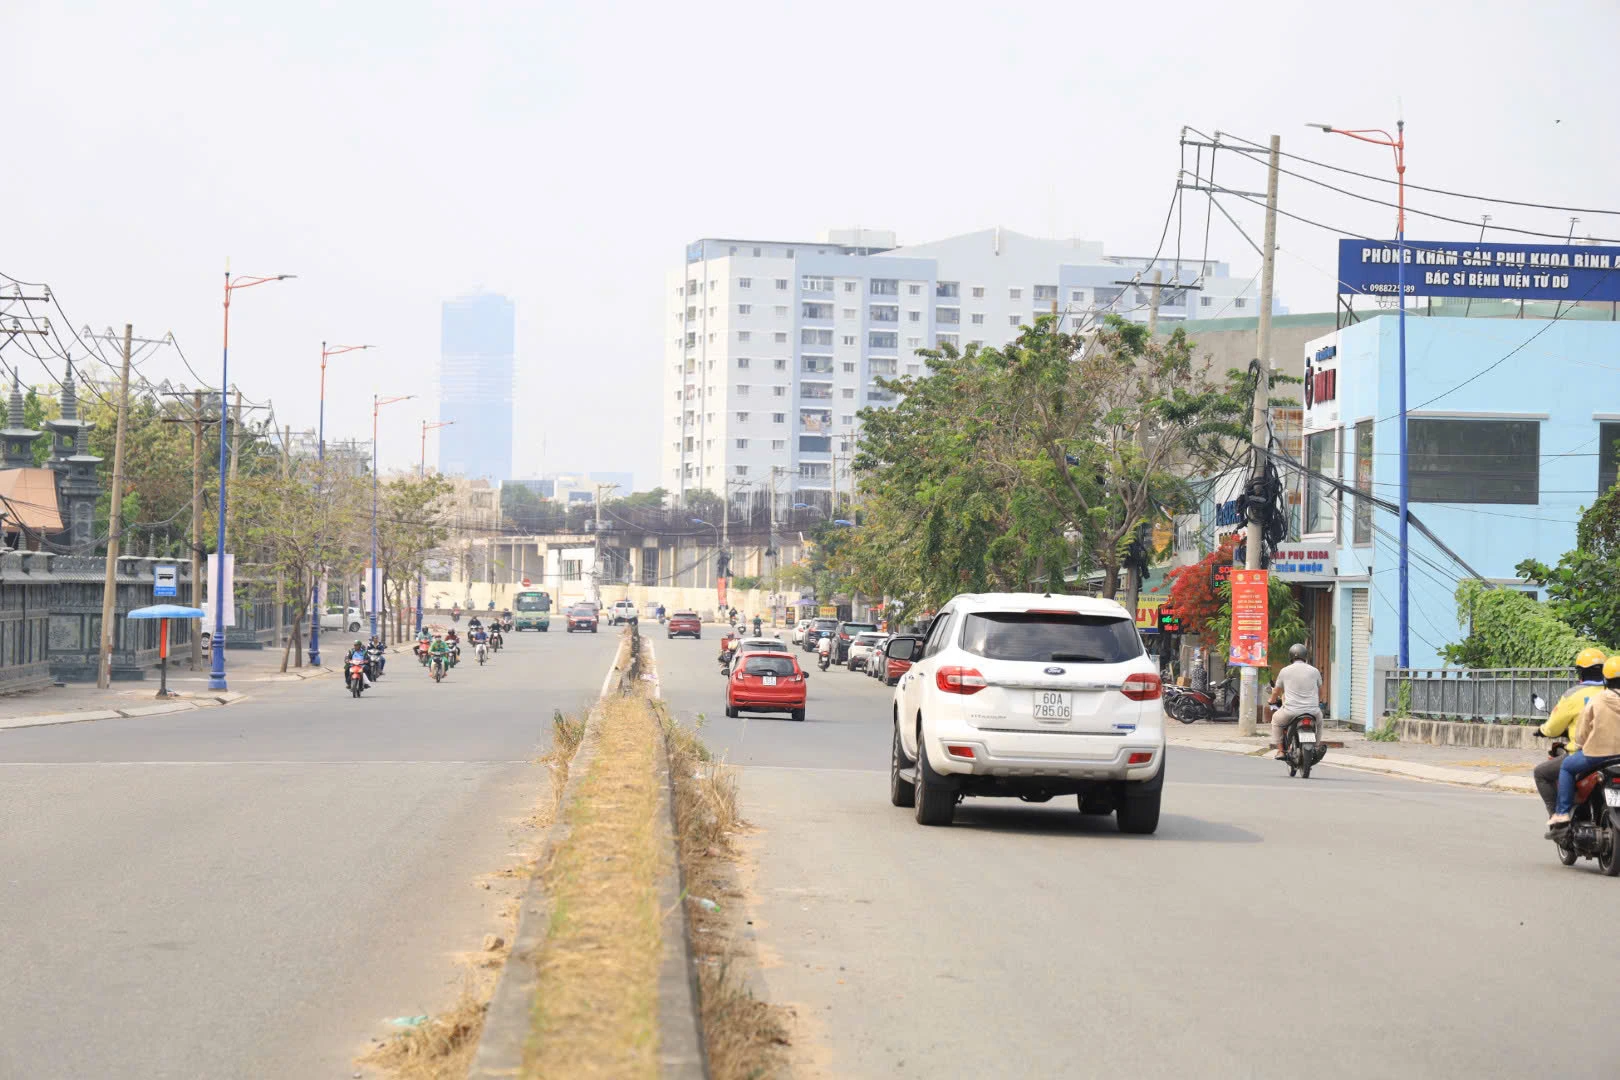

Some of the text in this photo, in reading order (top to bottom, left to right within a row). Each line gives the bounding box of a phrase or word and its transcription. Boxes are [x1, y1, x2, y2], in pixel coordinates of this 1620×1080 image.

[1361, 245, 1412, 264] PHÒNG
[1416, 247, 1458, 266] KHÁM
[1463, 246, 1492, 267] SẢN
[1496, 251, 1526, 270] PHỤ
[1530, 252, 1569, 269] KHOA
[1574, 251, 1610, 268] BÌNH
[1425, 269, 1450, 285] BÁC
[1469, 270, 1500, 289] BỆNH
[1503, 271, 1530, 290] VIỆN
[1533, 271, 1550, 288] TỪ
[1552, 273, 1569, 289] DŨ
[1370, 283, 1415, 293] 098822589
[1307, 550, 1329, 560] KHOA
[1043, 692, 1063, 705] 60A
[1035, 704, 1070, 718] 785.06
